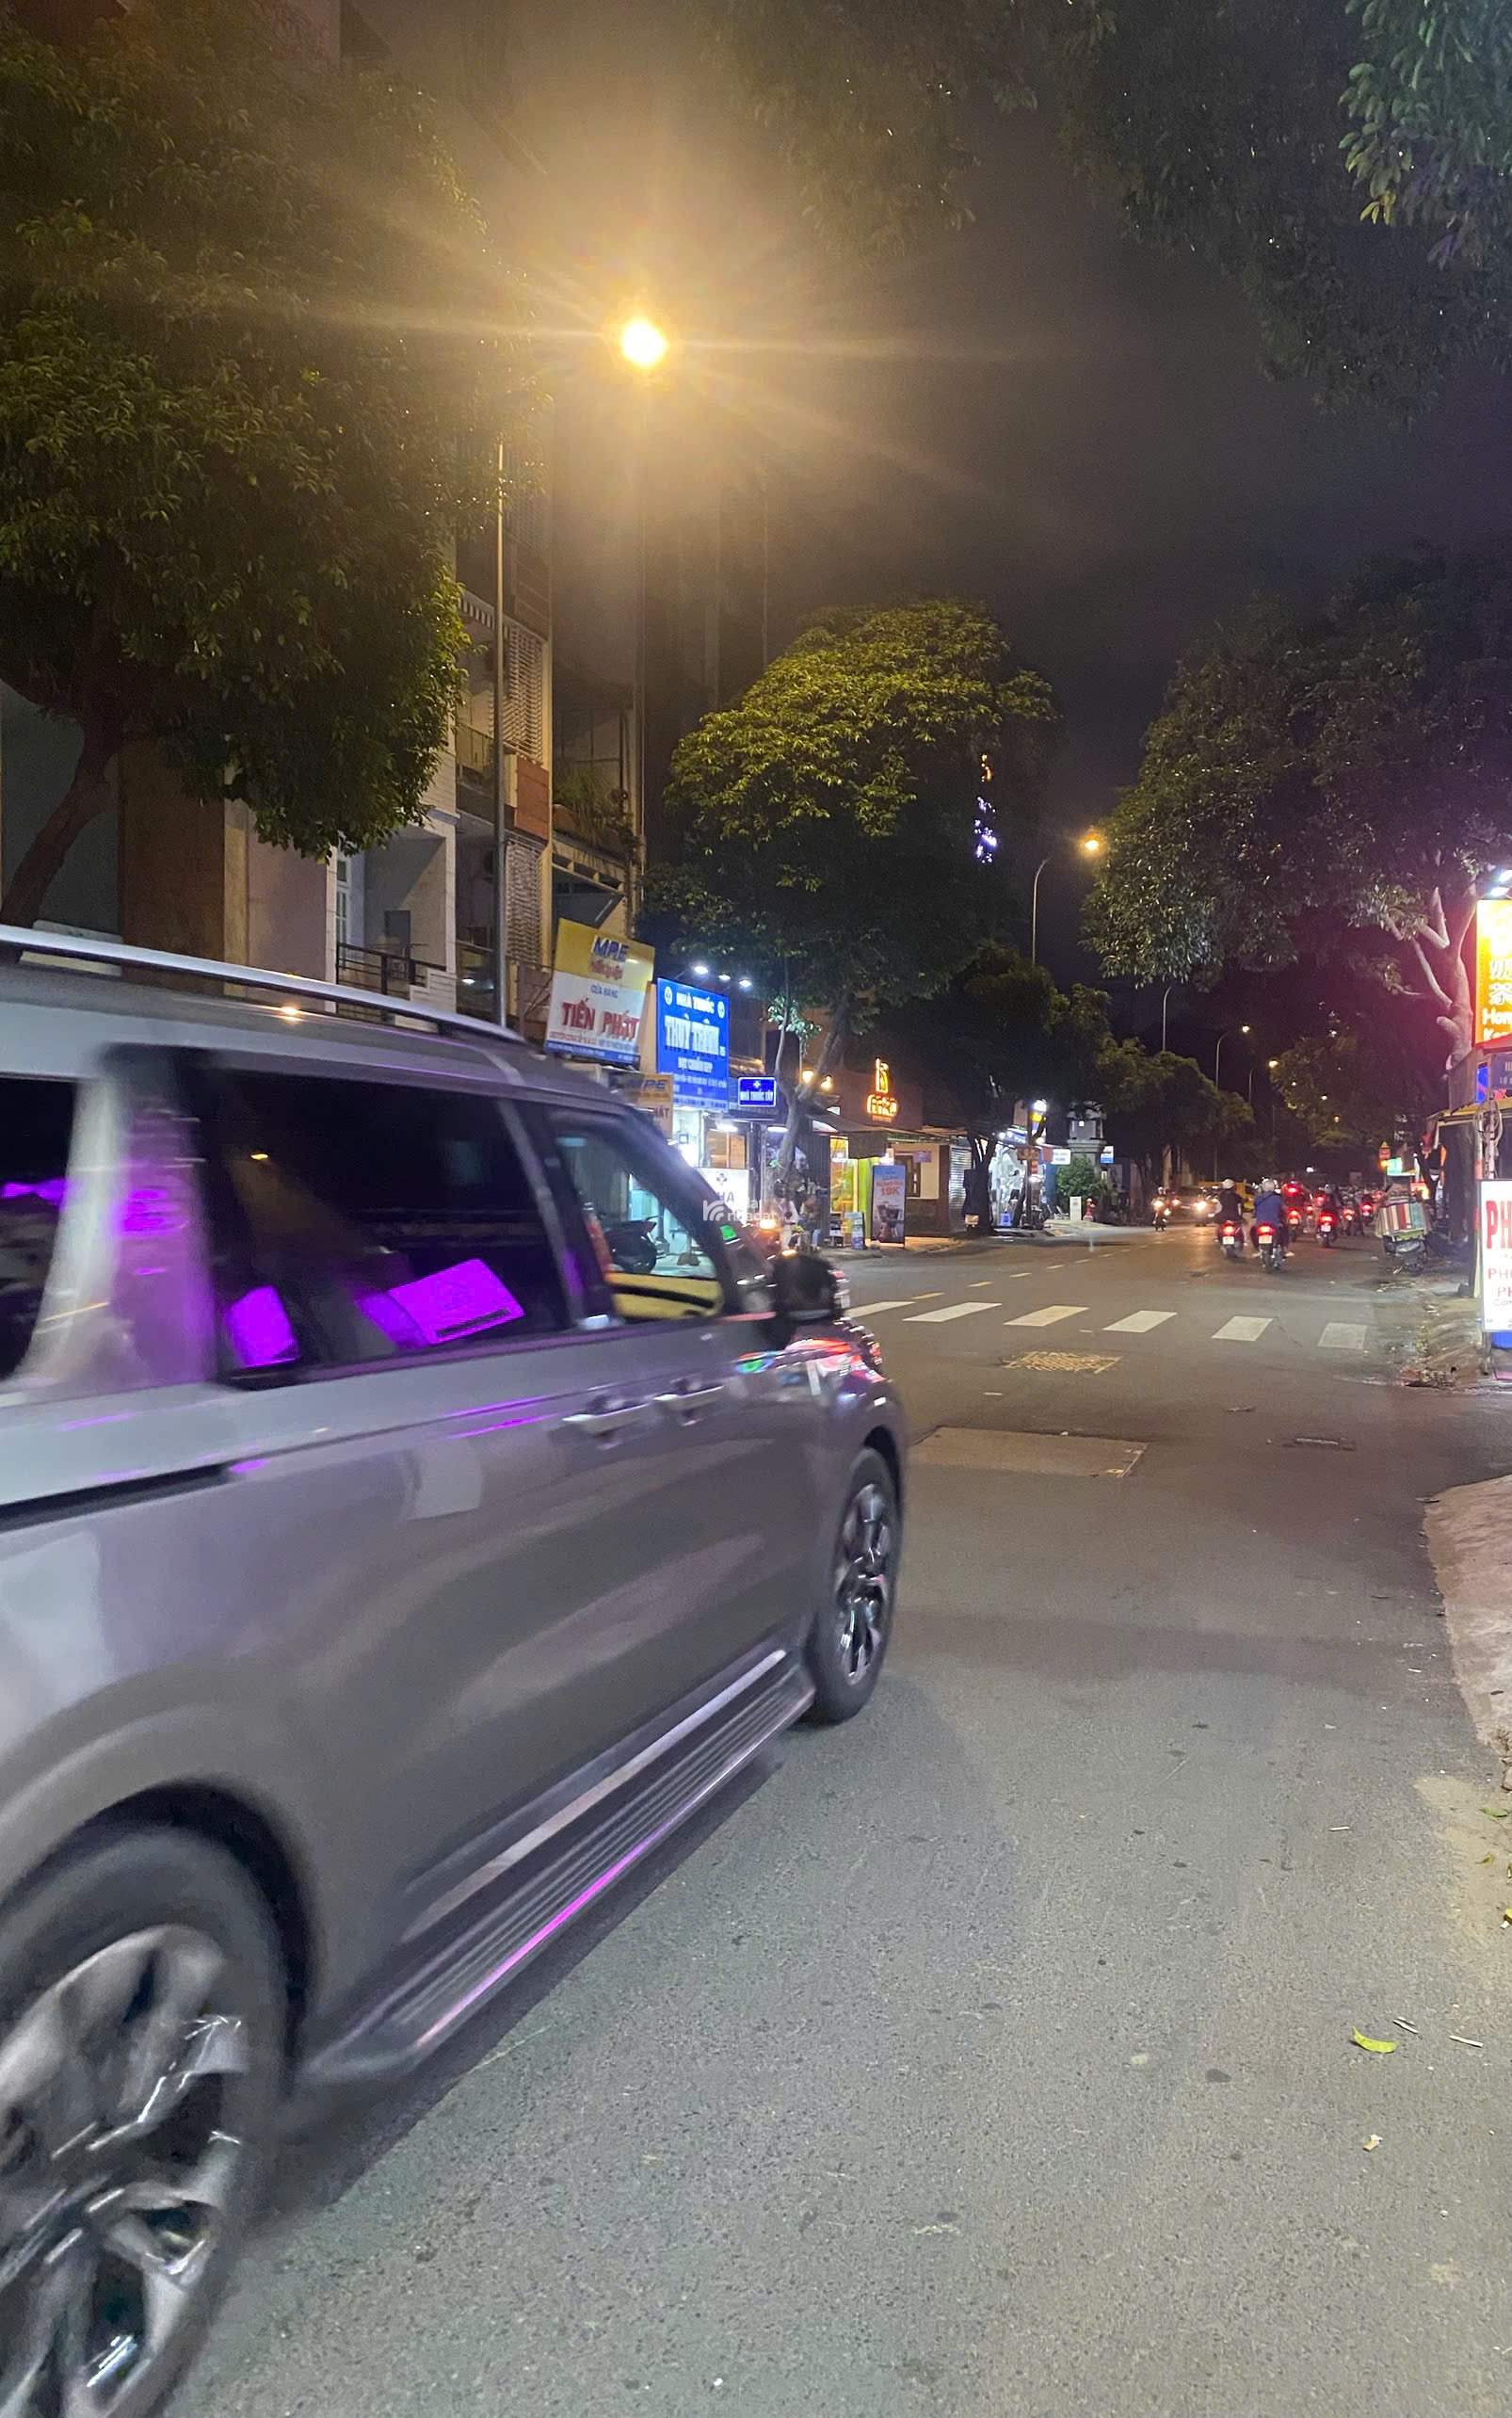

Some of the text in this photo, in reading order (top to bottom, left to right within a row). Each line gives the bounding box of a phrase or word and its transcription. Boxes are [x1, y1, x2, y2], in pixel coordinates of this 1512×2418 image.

[591, 936, 629, 962] MPE
[562, 997, 595, 1030] TIẾN
[640, 1080, 668, 1091] PE
